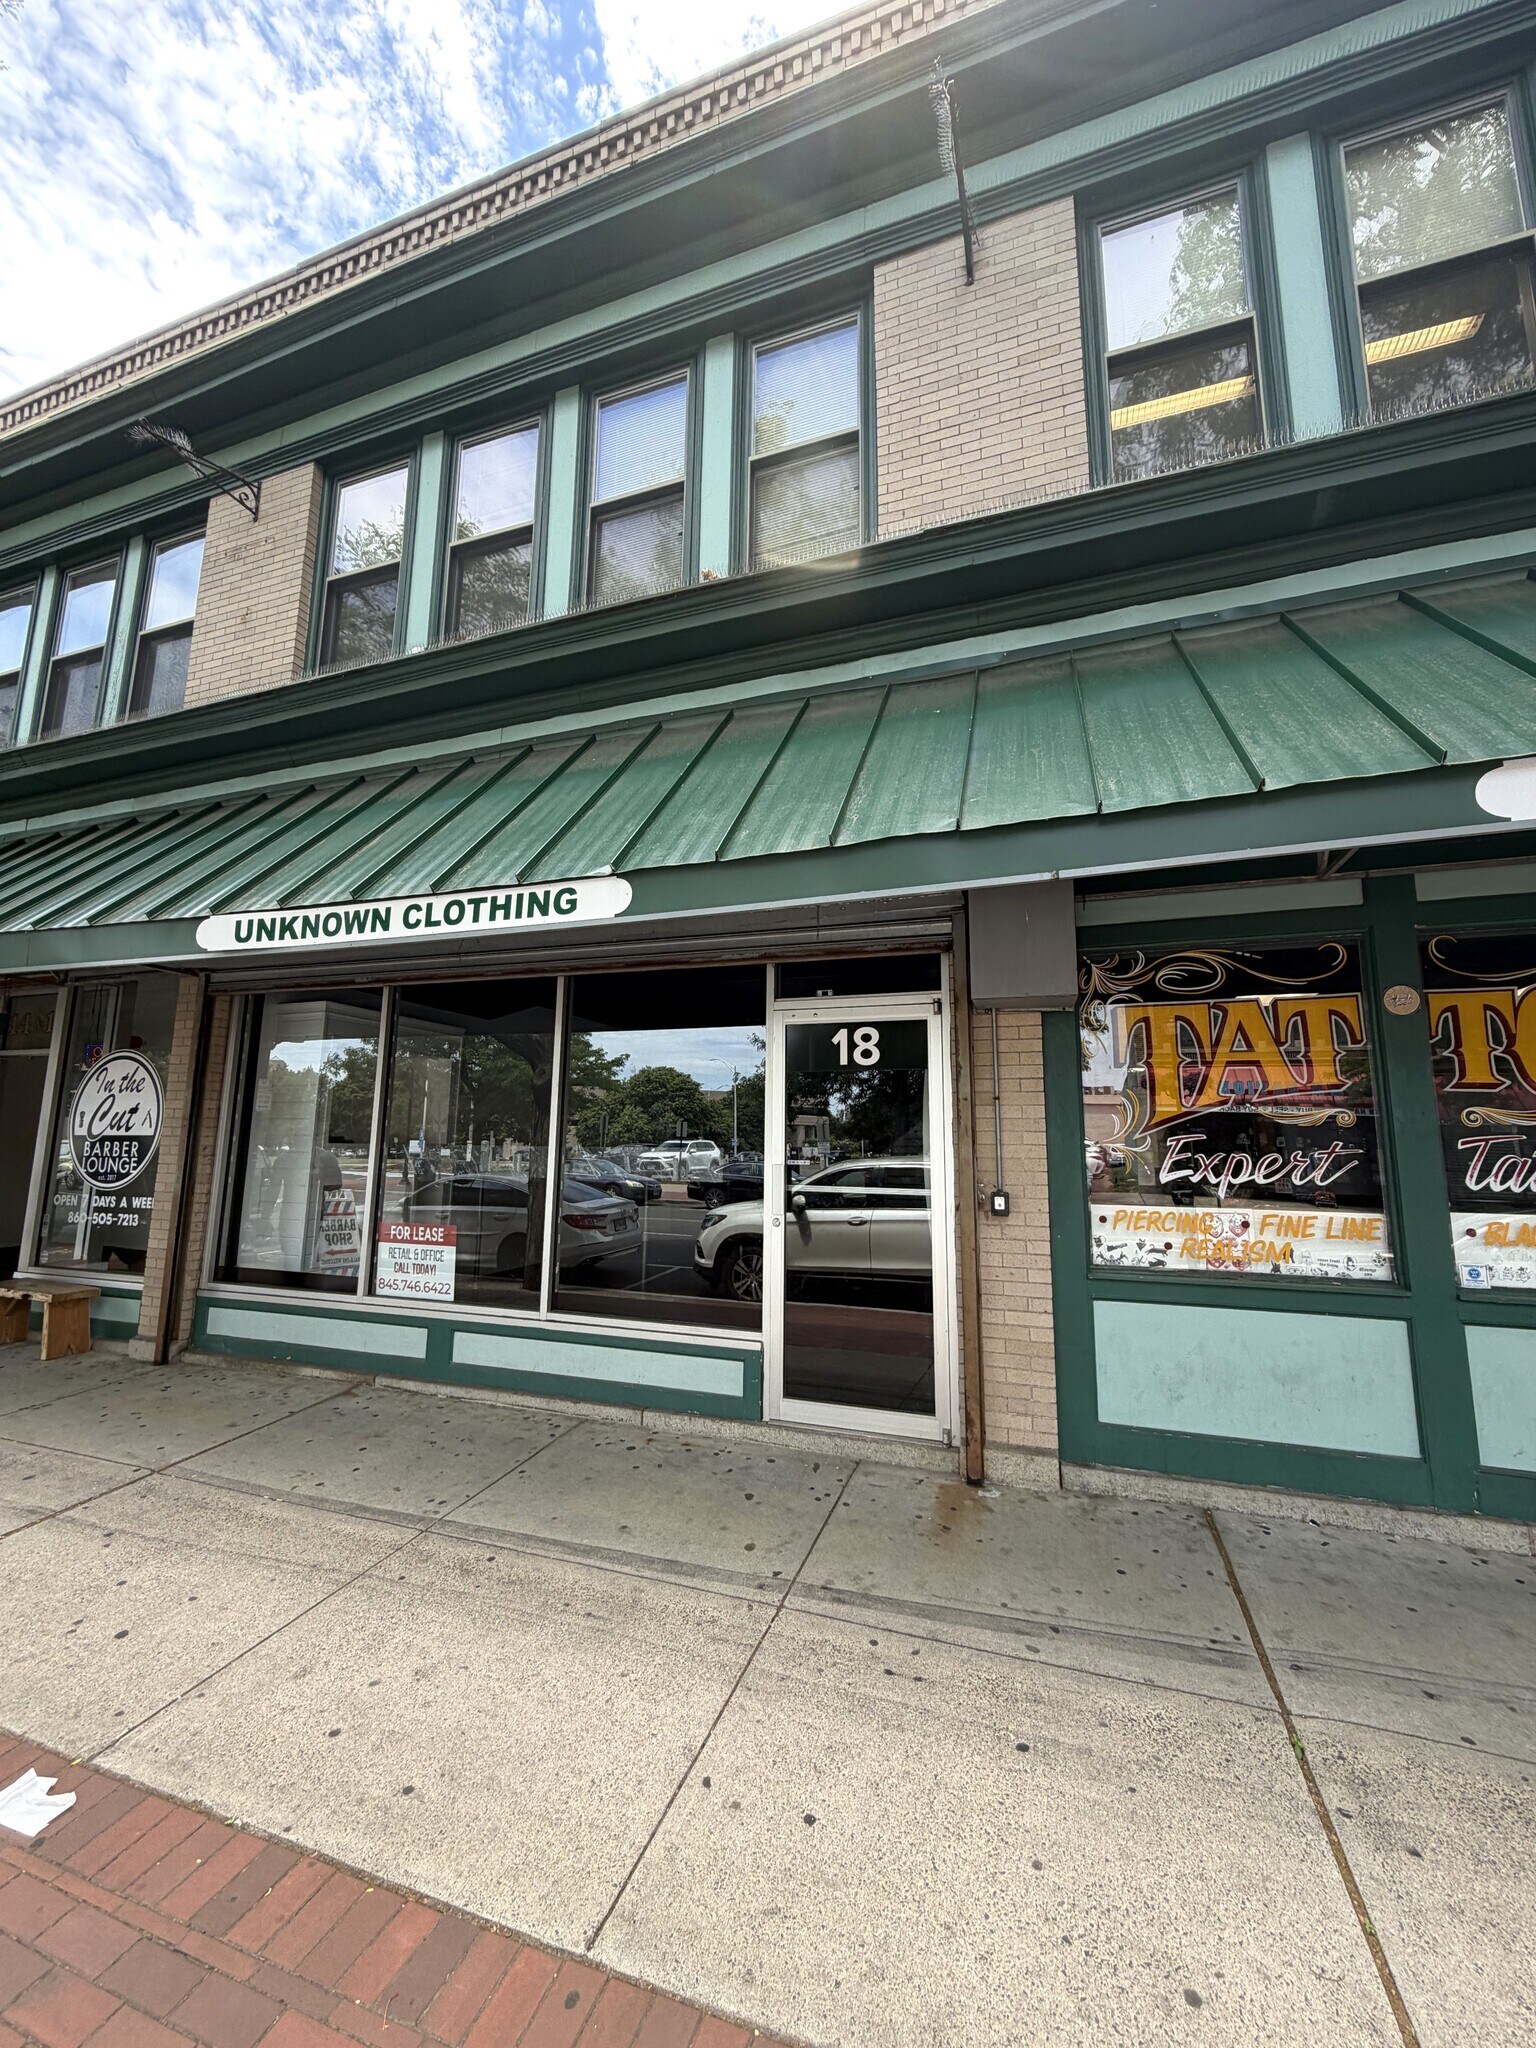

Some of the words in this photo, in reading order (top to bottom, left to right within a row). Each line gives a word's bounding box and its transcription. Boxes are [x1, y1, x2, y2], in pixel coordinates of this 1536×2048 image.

[234, 906, 391, 944] UNKNOWN
[402, 886, 578, 930] CLOTHING
[831, 1026, 881, 1066] 18
[1423, 985, 1536, 1094] T
[1110, 991, 1367, 1139] TAT
[95, 1066, 116, 1094] In
[118, 1065, 146, 1094] the
[86, 1093, 141, 1141] Cut
[83, 1141, 139, 1157] BARBER
[81, 1156, 138, 1174] LOUNGE
[1159, 1133, 1365, 1200] Expert
[1457, 1134, 1536, 1193] Ta
[53, 1194, 78, 1206] OPEN
[82, 1194, 89, 1208] 7
[92, 1195, 117, 1208] DAYS
[119, 1196, 128, 1209] A
[132, 1196, 155, 1209] WEE
[67, 1211, 139, 1227] 860-505-7213
[1113, 1209, 1215, 1234] PIERCING
[1259, 1213, 1318, 1239] FINE
[1325, 1215, 1382, 1241] LINE
[390, 1225, 410, 1240] FOR
[413, 1226, 445, 1242] LEASE
[388, 1246, 411, 1260] RETAIL
[413, 1250, 420, 1260] &
[420, 1249, 445, 1262] OFFICE
[1179, 1237, 1292, 1264] REALISM
[393, 1261, 410, 1274] CALL
[412, 1262, 437, 1276] TODAY!
[378, 1278, 451, 1295] 845.746.6422
